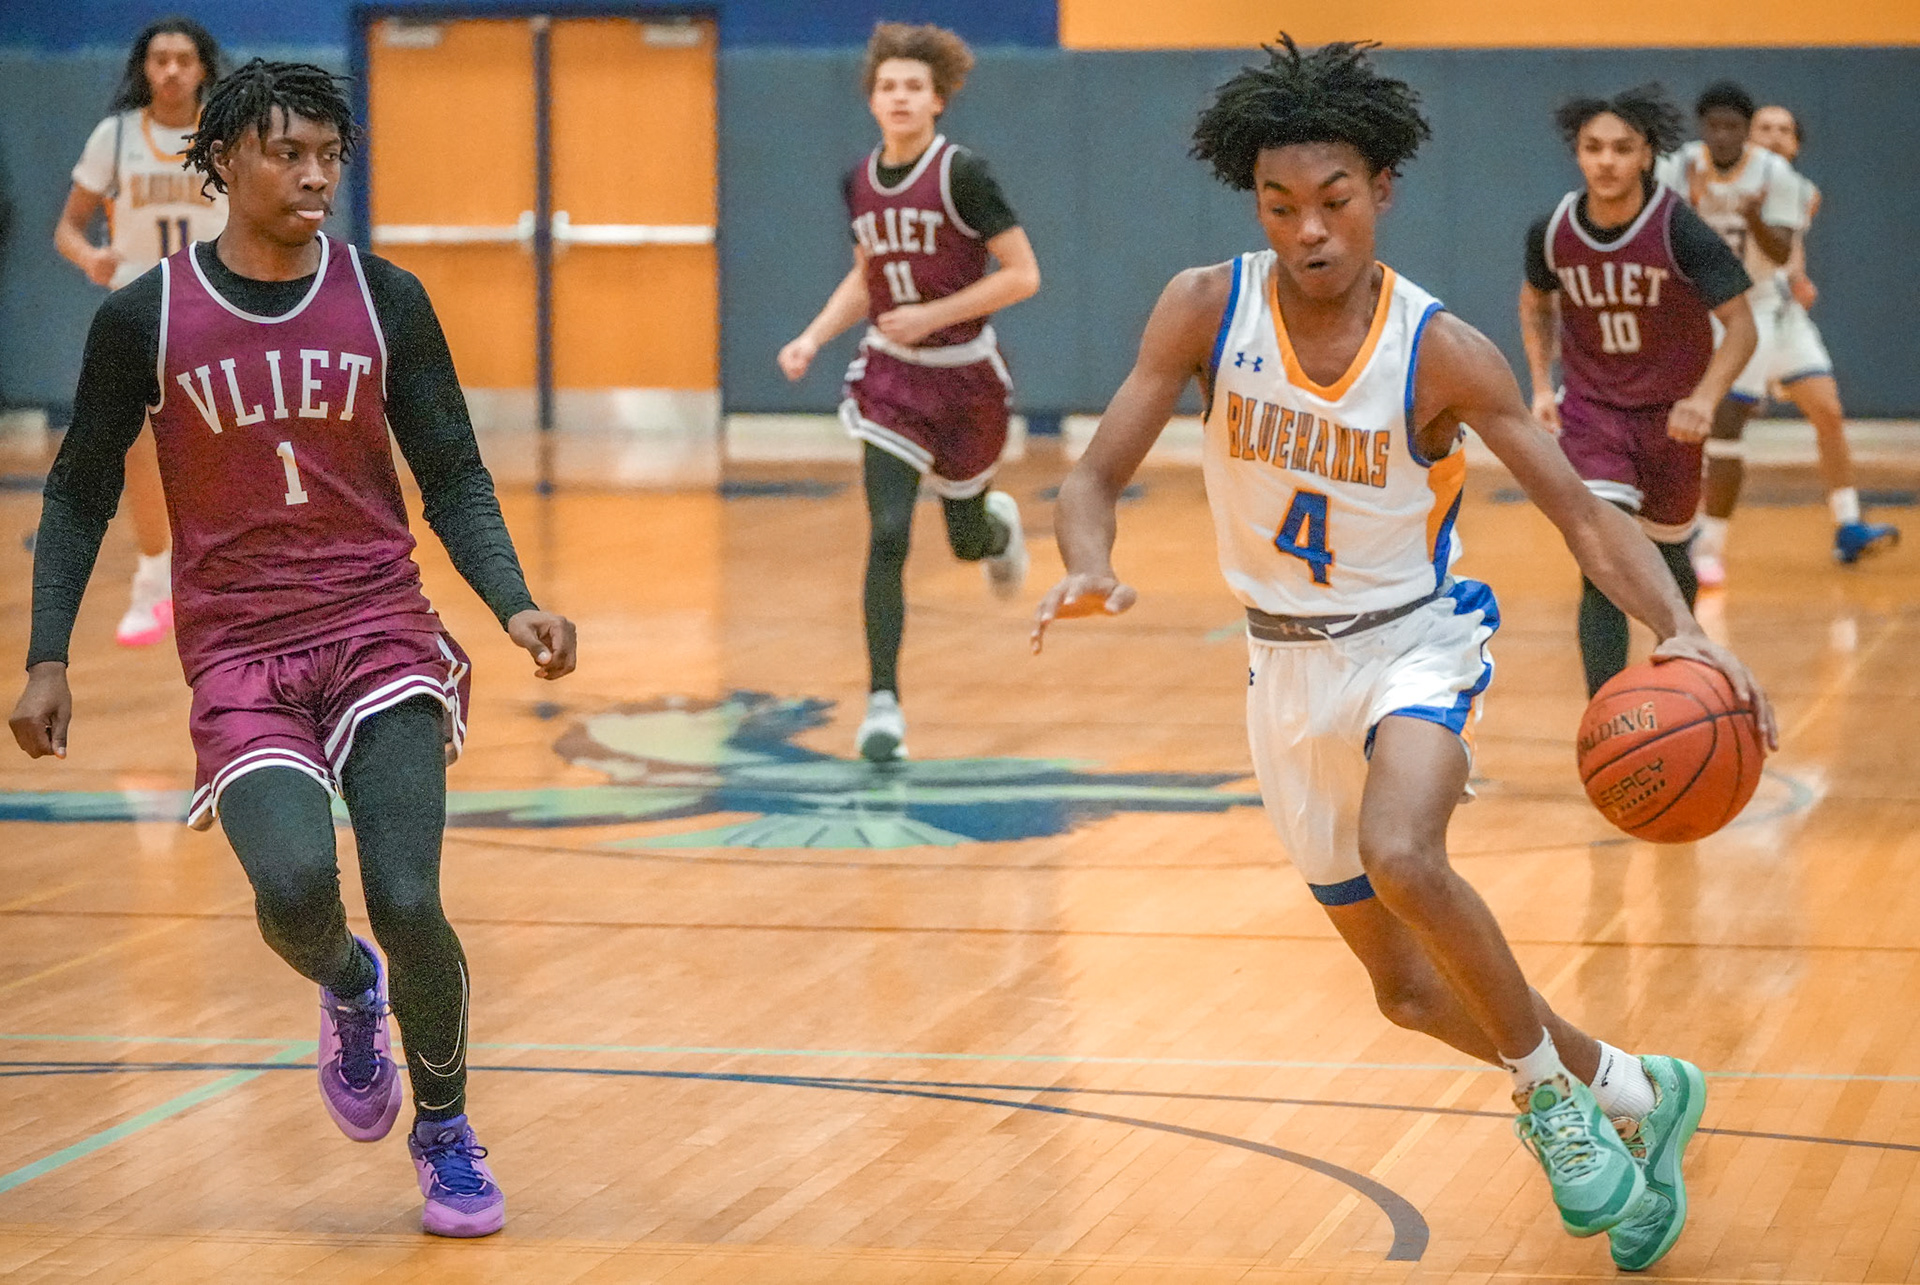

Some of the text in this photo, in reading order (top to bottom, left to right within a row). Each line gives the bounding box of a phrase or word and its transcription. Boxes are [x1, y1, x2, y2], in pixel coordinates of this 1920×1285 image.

[883, 261, 921, 303] 11
[1557, 262, 1669, 306] VLIET
[1598, 312, 1641, 353] 10
[176, 349, 372, 434] VLIET
[276, 441, 308, 505] 1
[1274, 487, 1335, 588] 4
[1577, 701, 1658, 756] ALDING
